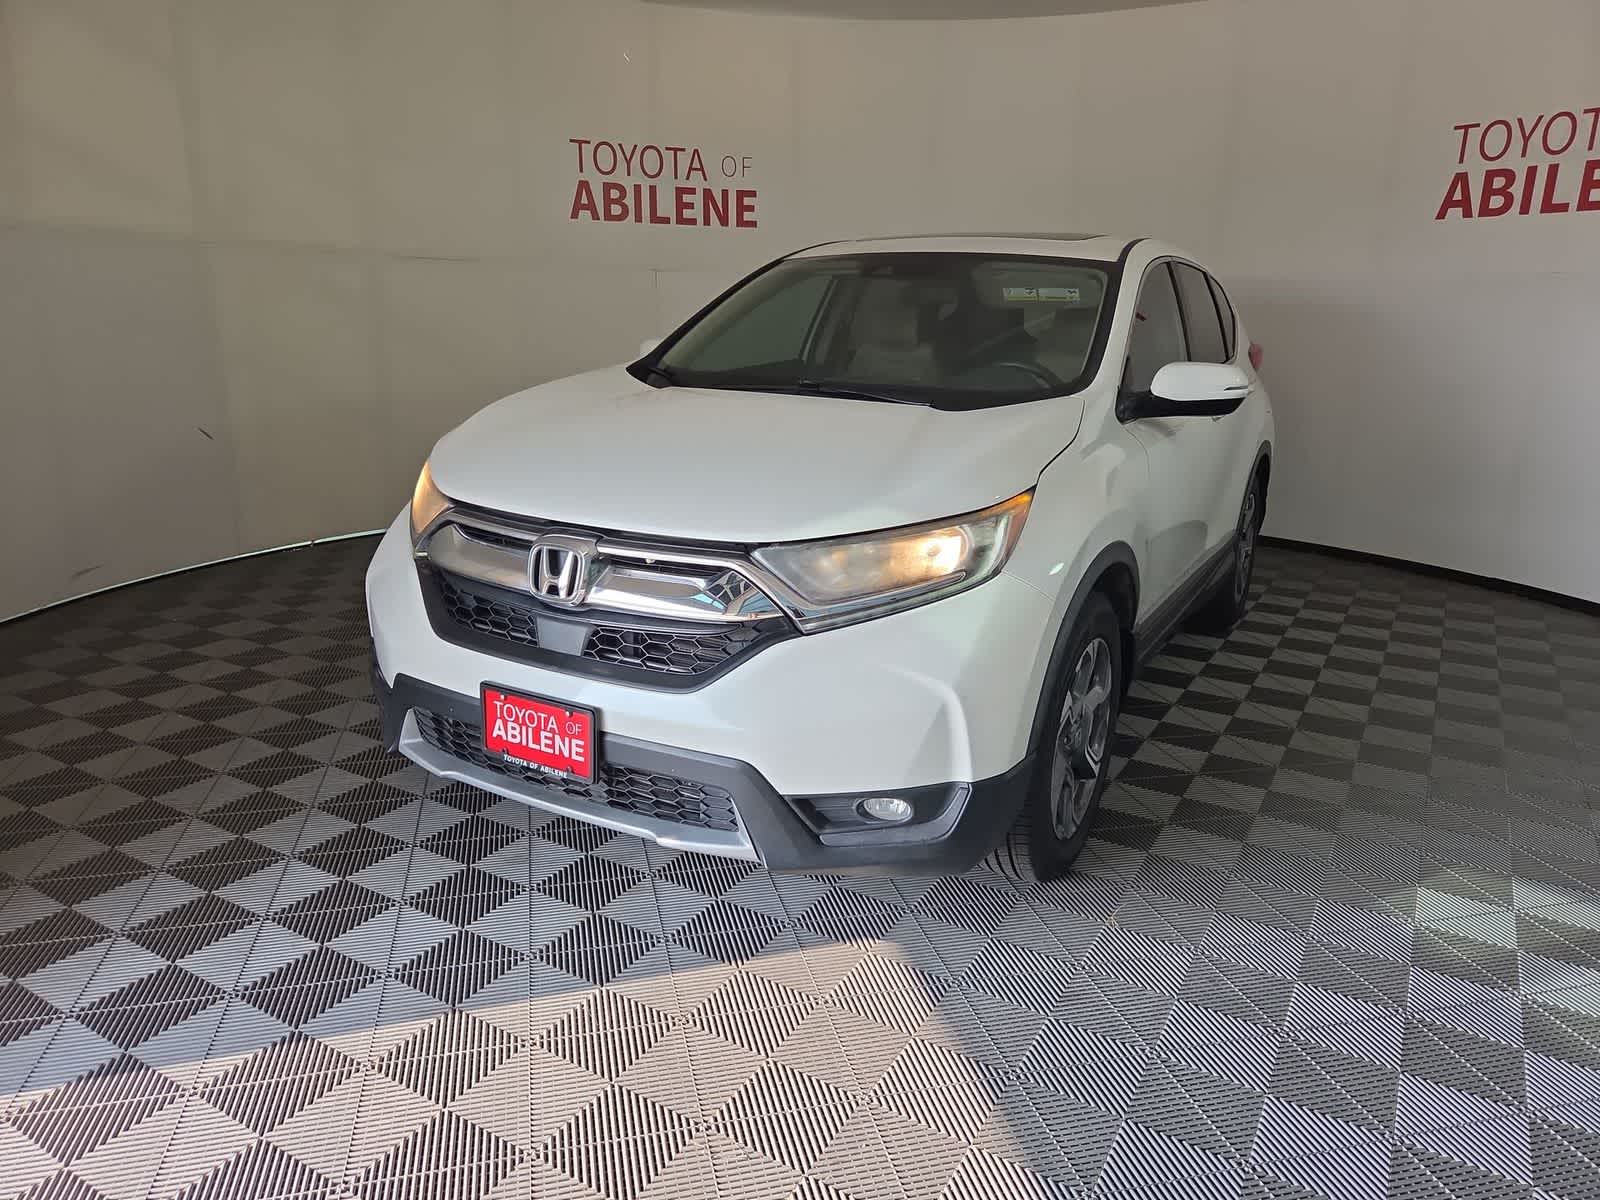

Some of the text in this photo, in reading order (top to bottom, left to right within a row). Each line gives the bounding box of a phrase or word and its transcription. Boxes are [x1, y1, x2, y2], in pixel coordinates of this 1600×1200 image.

[569, 138, 753, 182] TOYOTA OF
[570, 180, 758, 228] ABILENE
[493, 700, 583, 735] TOYOTA OF
[492, 718, 585, 762] ABILENE
[503, 754, 528, 767] TOYOTA
[540, 765, 568, 779] ABILENE
